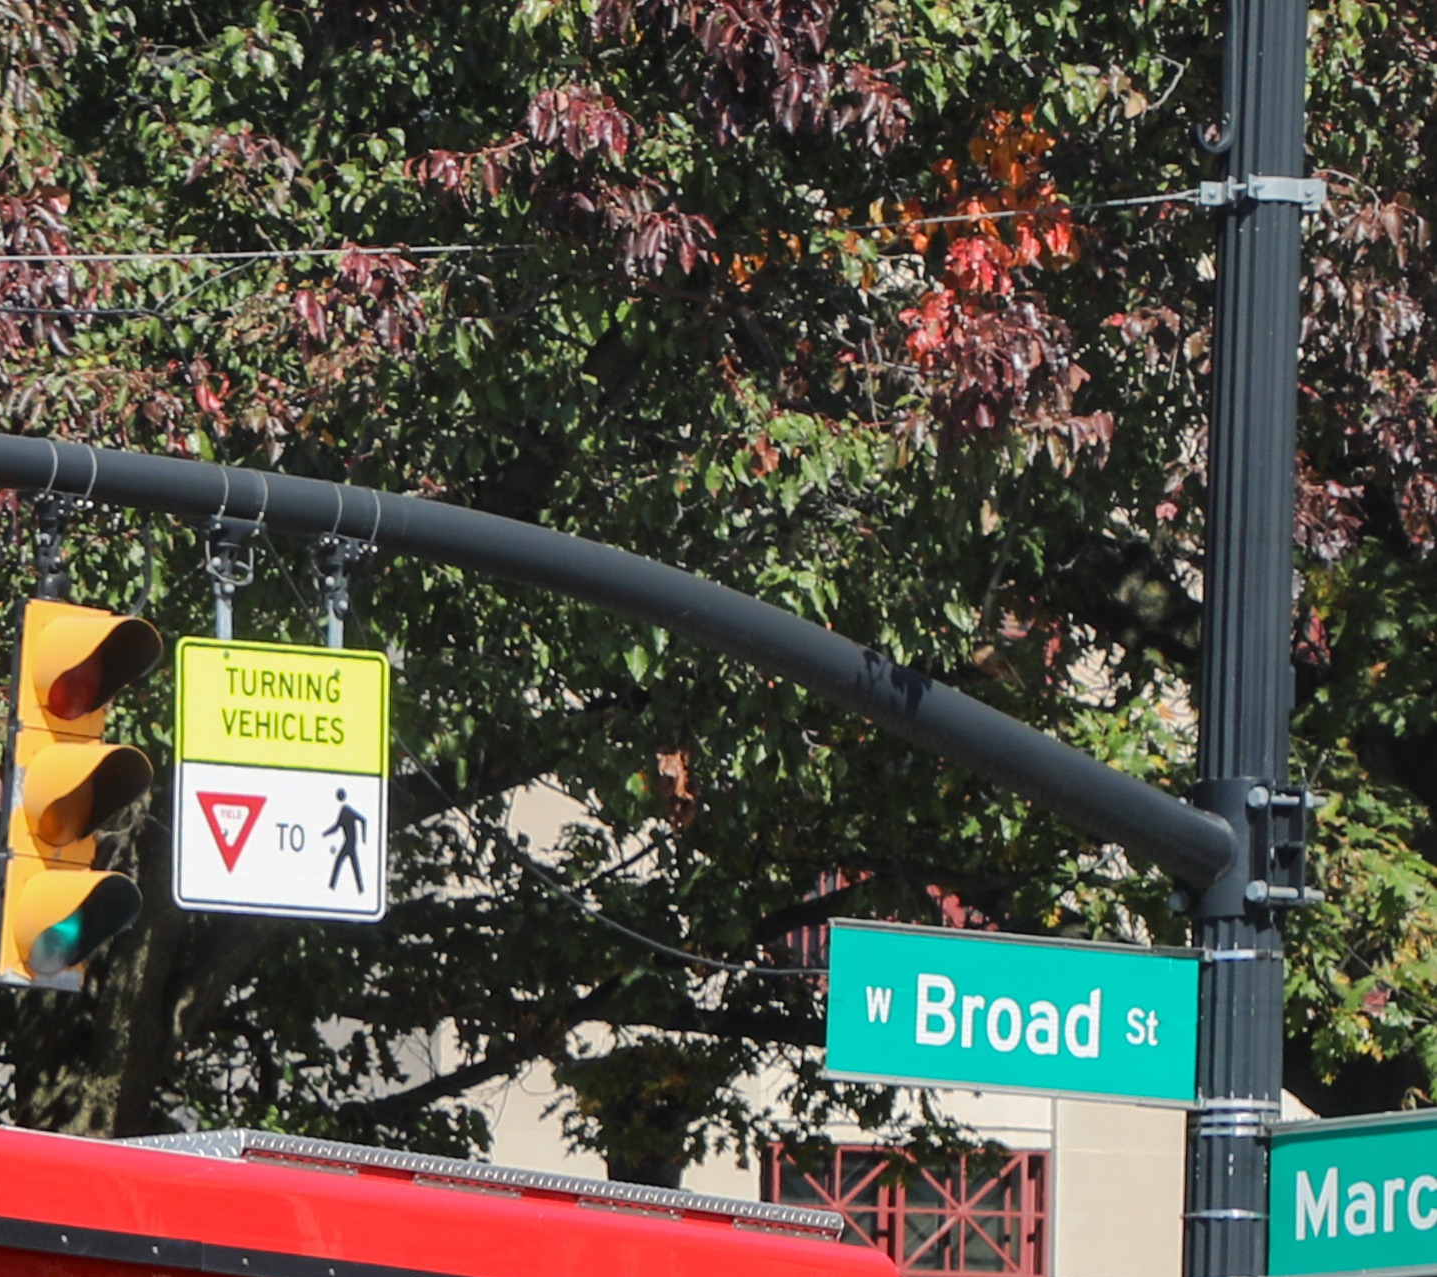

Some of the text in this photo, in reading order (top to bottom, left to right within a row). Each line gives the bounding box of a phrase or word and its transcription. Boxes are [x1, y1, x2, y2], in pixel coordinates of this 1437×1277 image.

[225, 667, 341, 704] TURNING
[221, 707, 345, 746] VEHICLES
[276, 822, 306, 853] TO
[865, 973, 1160, 1059] W Broad St
[1295, 1166, 1437, 1241] Marc
